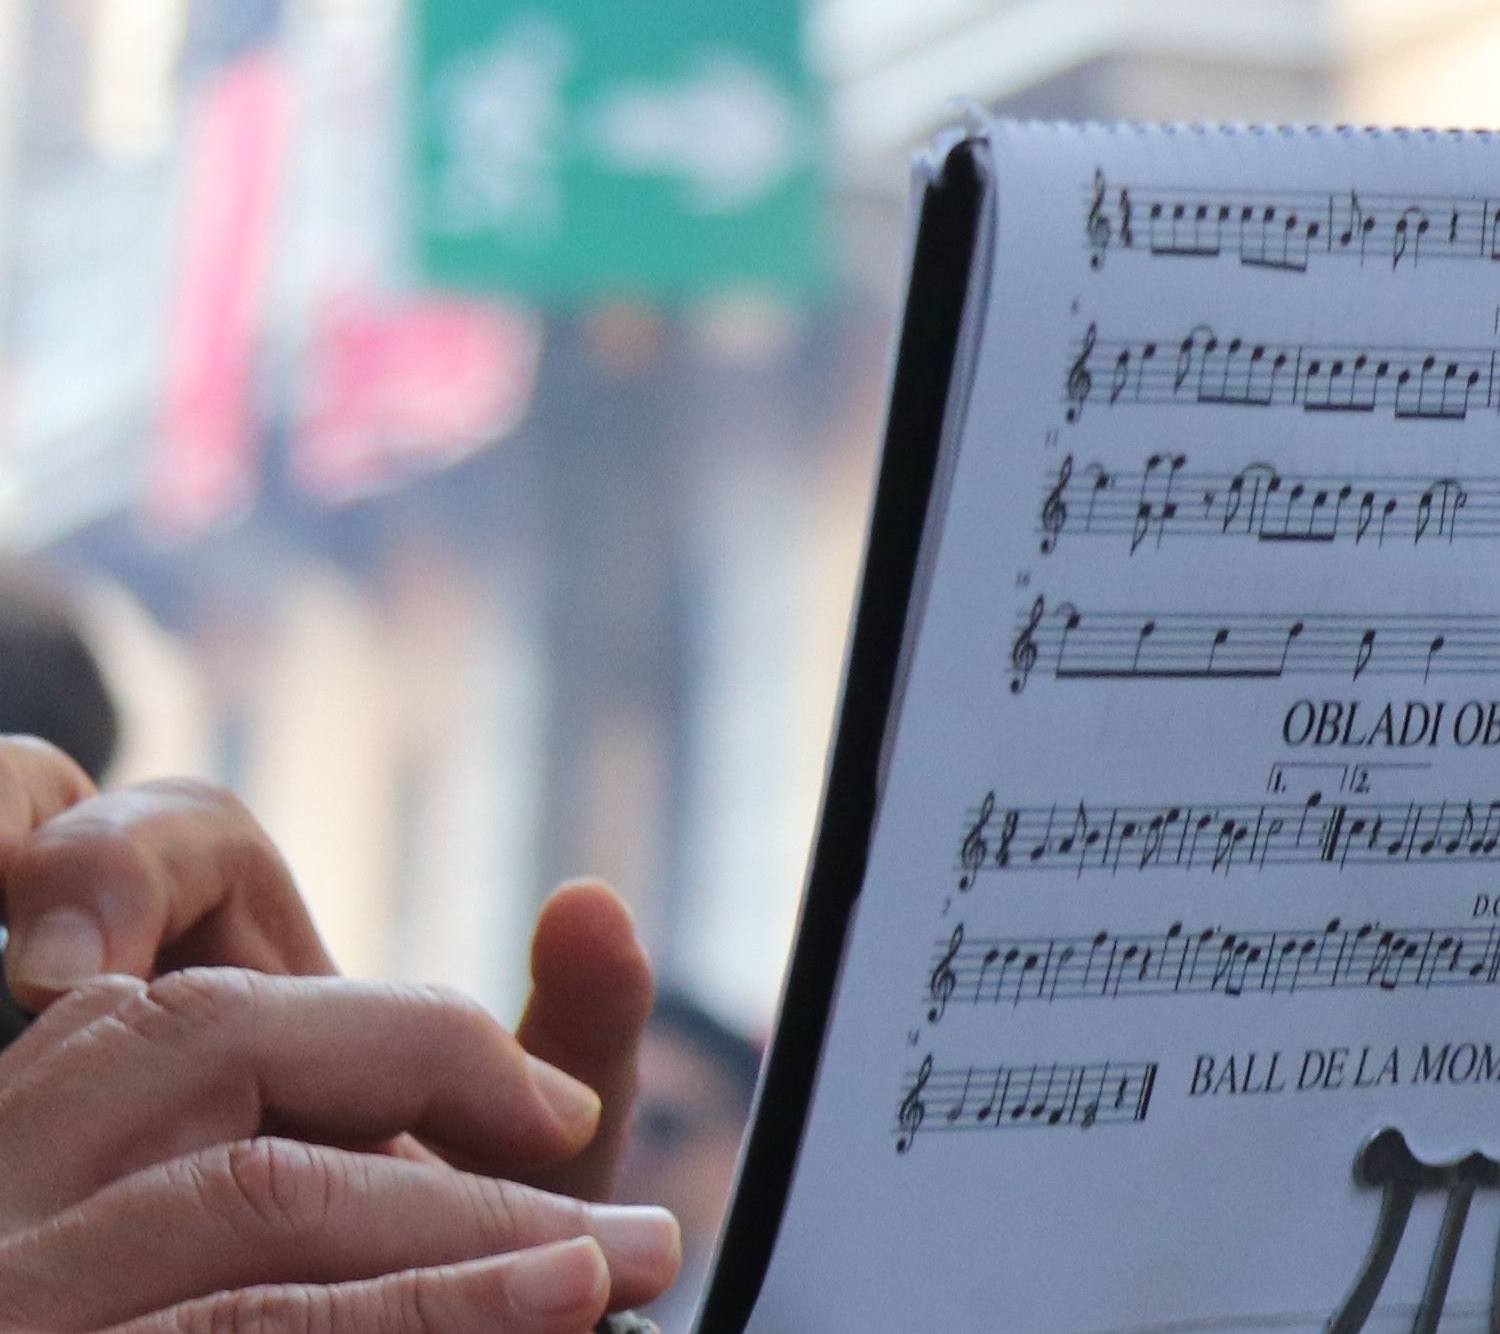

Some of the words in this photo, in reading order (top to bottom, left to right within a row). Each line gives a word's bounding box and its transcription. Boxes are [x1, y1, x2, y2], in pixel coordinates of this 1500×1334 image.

[1281, 698, 1447, 747] OBLADI
[1188, 1051, 1286, 1097] BALL
[1296, 1045, 1350, 1092] DE
[1353, 1043, 1401, 1088] LA
